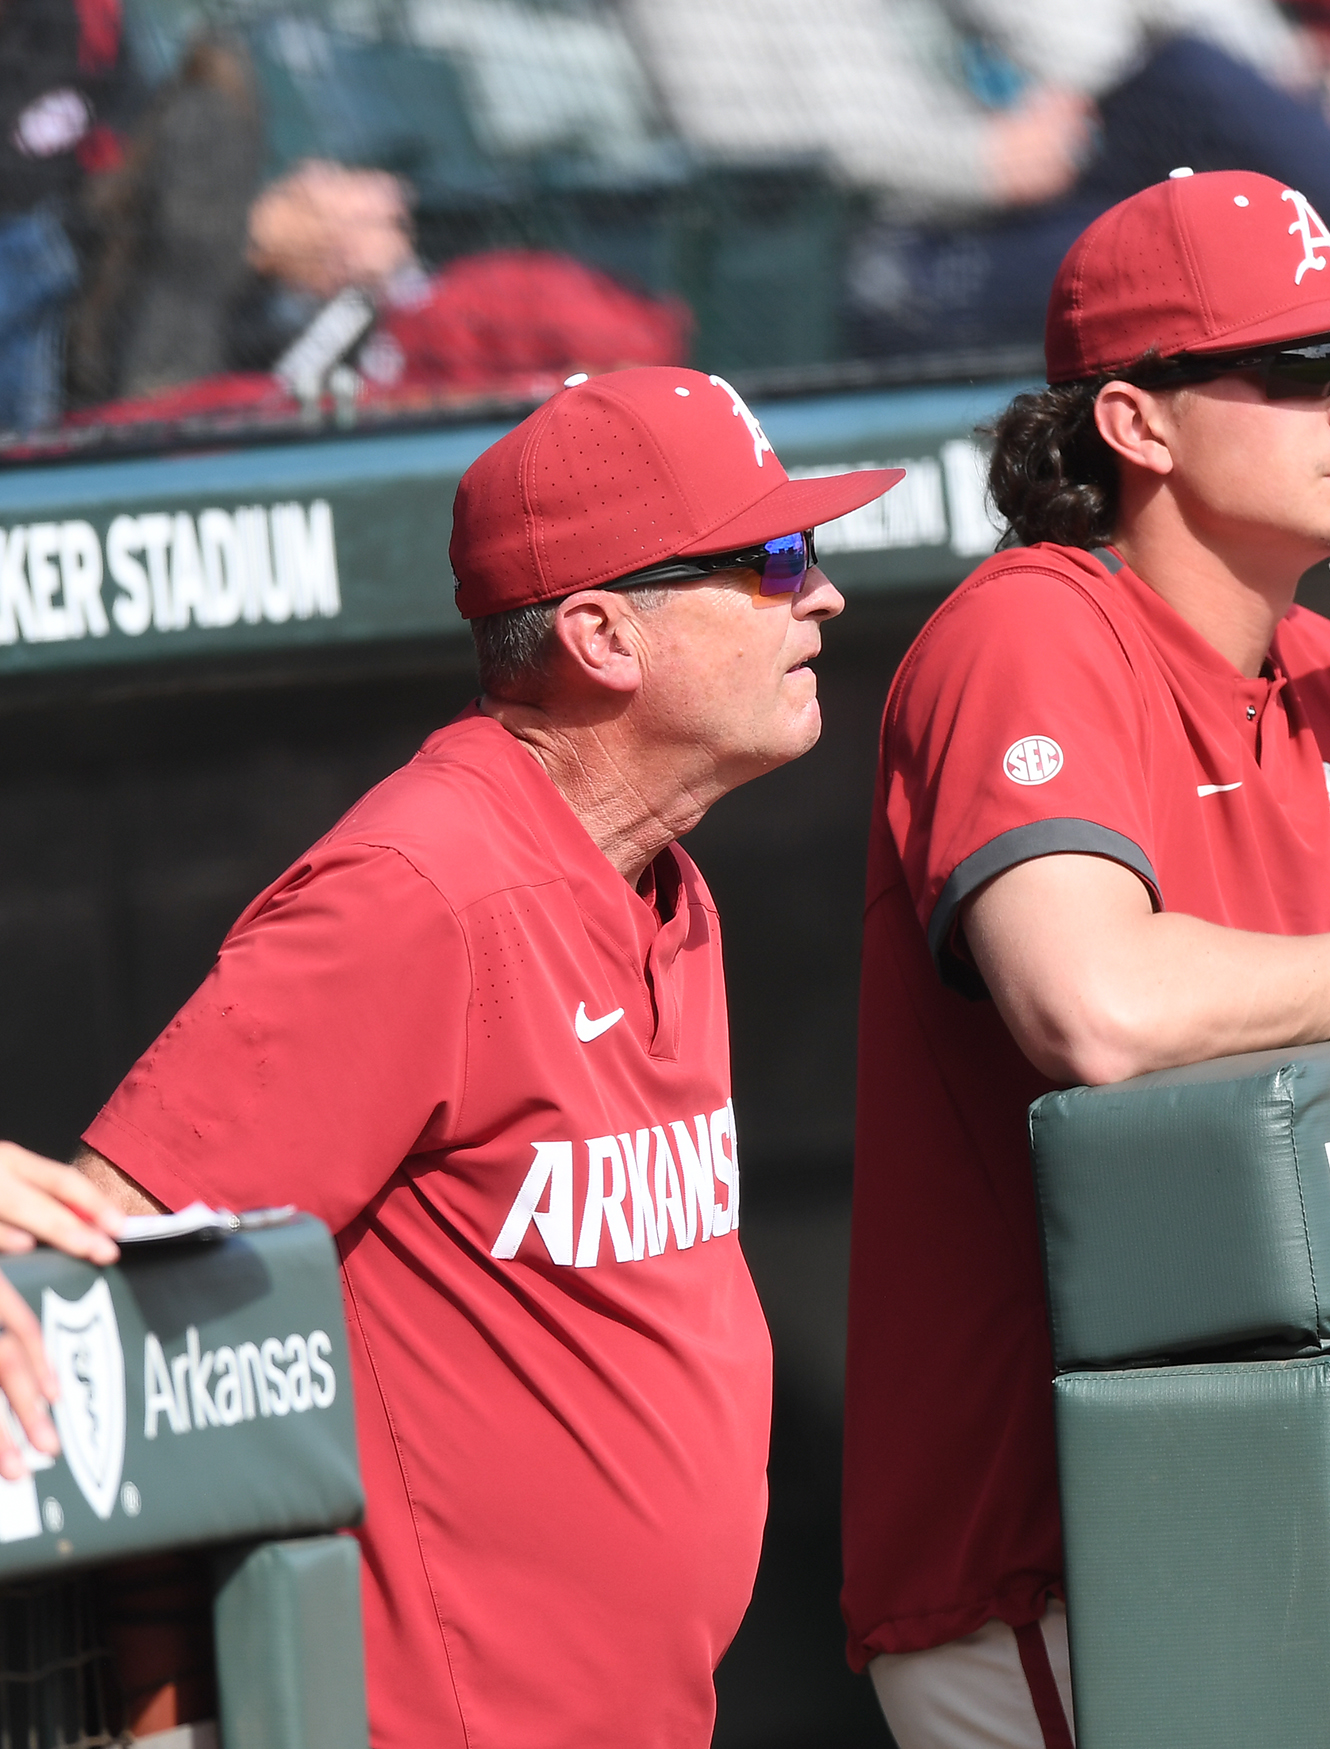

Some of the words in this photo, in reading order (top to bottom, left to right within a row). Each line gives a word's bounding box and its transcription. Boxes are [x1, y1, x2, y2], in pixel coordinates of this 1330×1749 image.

[106, 498, 342, 637] STADIUM
[1007, 739, 1060, 781] SEC
[490, 1097, 740, 1268] ARKANS
[144, 1325, 336, 1440] Arkansas
